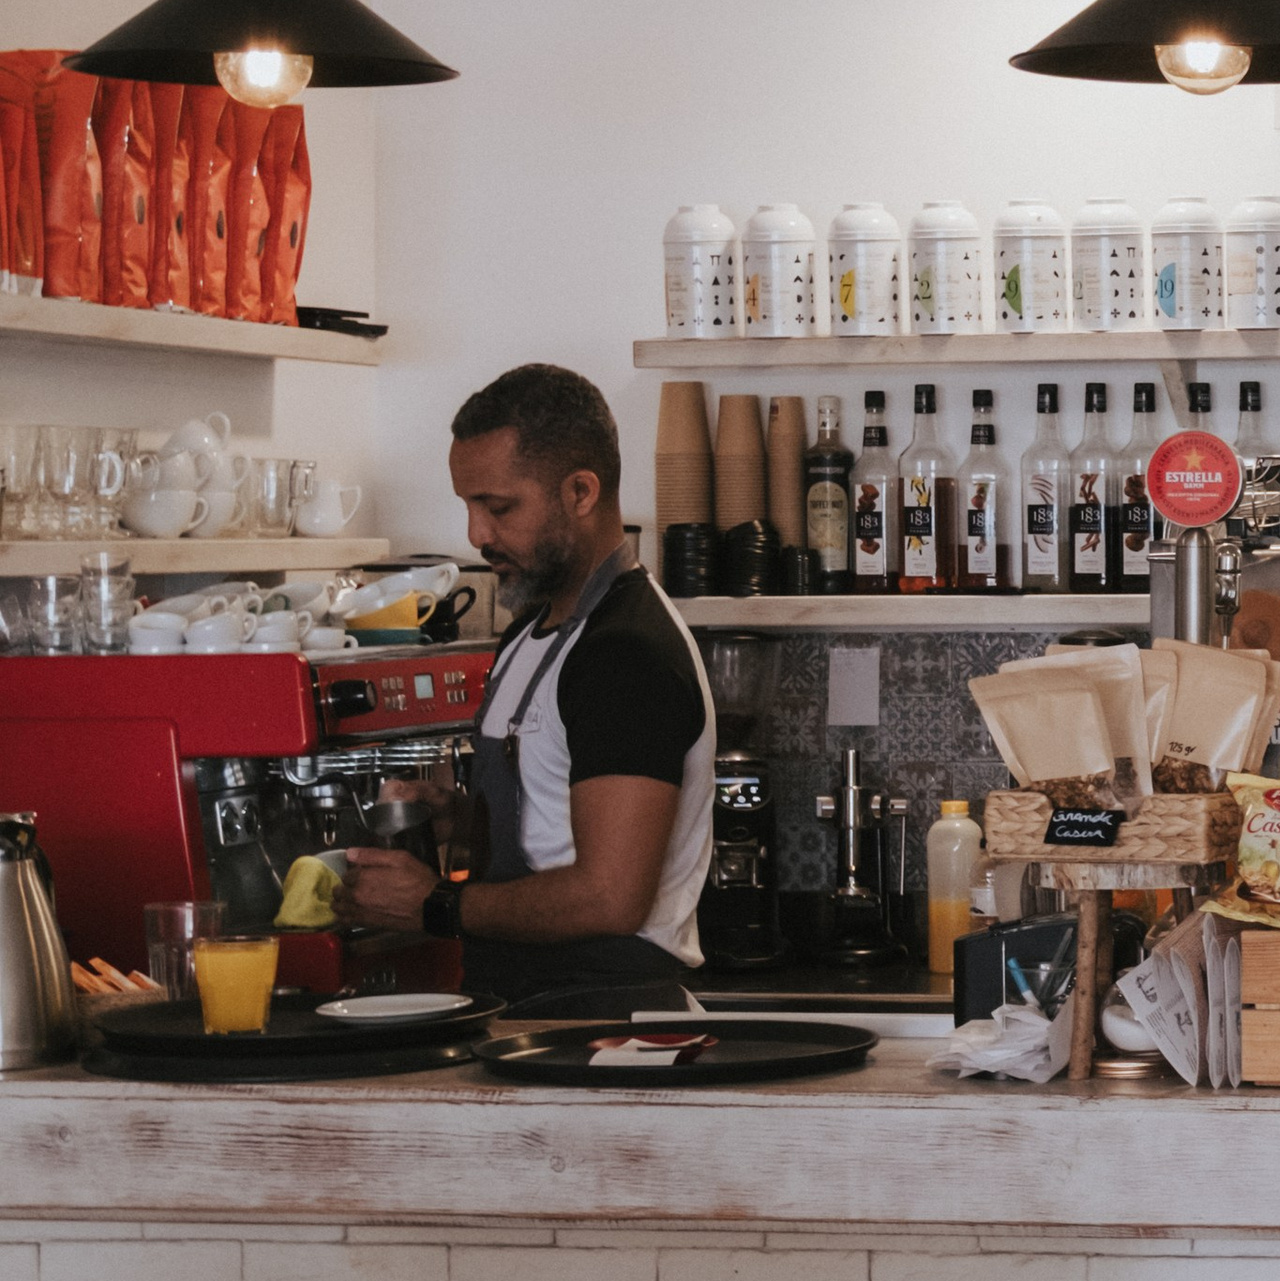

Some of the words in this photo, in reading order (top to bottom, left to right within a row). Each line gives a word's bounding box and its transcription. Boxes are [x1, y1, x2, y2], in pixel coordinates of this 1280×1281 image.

[842, 283, 852, 303] 7
[921, 280, 932, 300] 2
[1008, 280, 1018, 300] 9
[1159, 279, 1174, 299] 19
[1165, 471, 1222, 483] ESTRELLA
